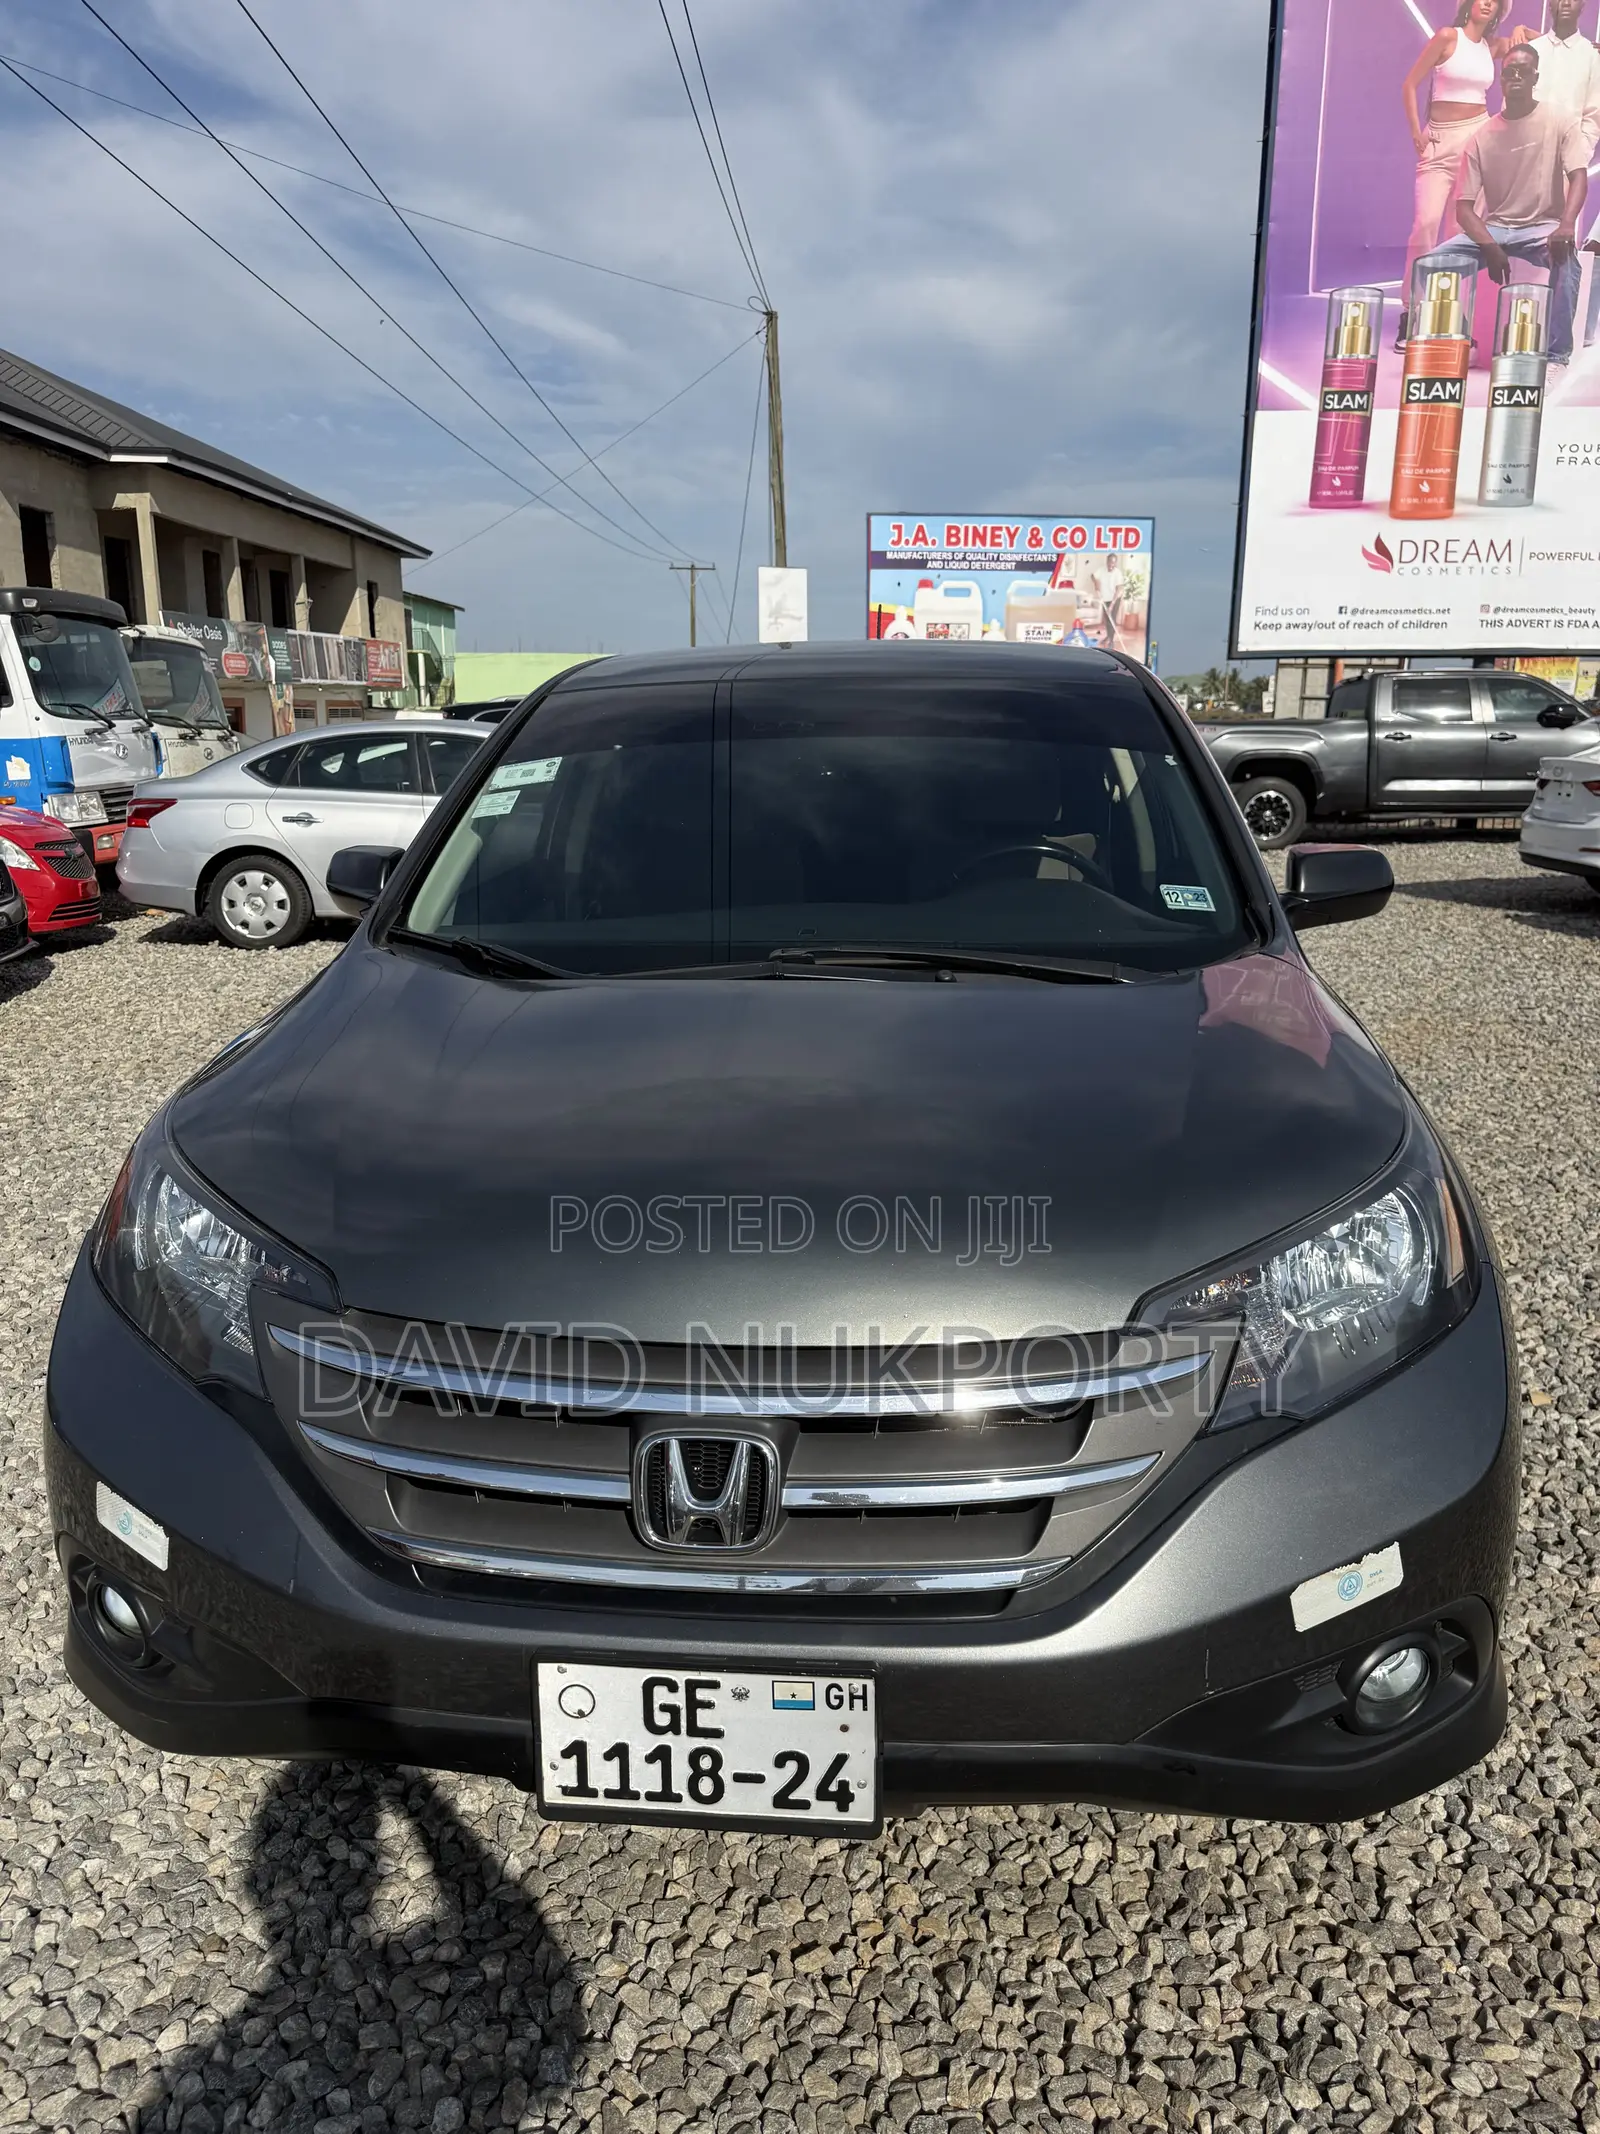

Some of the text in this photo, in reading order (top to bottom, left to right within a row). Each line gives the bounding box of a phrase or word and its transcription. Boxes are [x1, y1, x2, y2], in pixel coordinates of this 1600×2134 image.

[1408, 381, 1460, 400] SLAM
[1324, 393, 1368, 409] SLAM
[1493, 389, 1539, 405] SLAM
[889, 524, 1141, 550] J.A. BINEY & CO LTD
[886, 552, 1057, 562] MANUFACTURERS OF QUALITY DISINFECTANTS
[1399, 539, 1512, 563] DREAM
[1529, 552, 1595, 561] POWERFUL
[926, 561, 1016, 570] AND LIQUID DETERGENT
[1397, 567, 1511, 575] COSMETICS
[1255, 606, 1310, 616] Find us on
[1350, 607, 1451, 616] @dreamcosmetics.net
[1254, 620, 1448, 631] Keep away/out of reach of children
[1479, 619, 1503, 628] THIS
[1506, 619, 1551, 628] ADVERT
[1554, 619, 1564, 628] IS
[1567, 619, 1590, 629] FDA
[177, 622, 222, 640] Shelter Oasis
[1165, 891, 1208, 903] 12 23
[642, 1675, 868, 1739] GE GH
[560, 1739, 856, 1813] 1118-24
